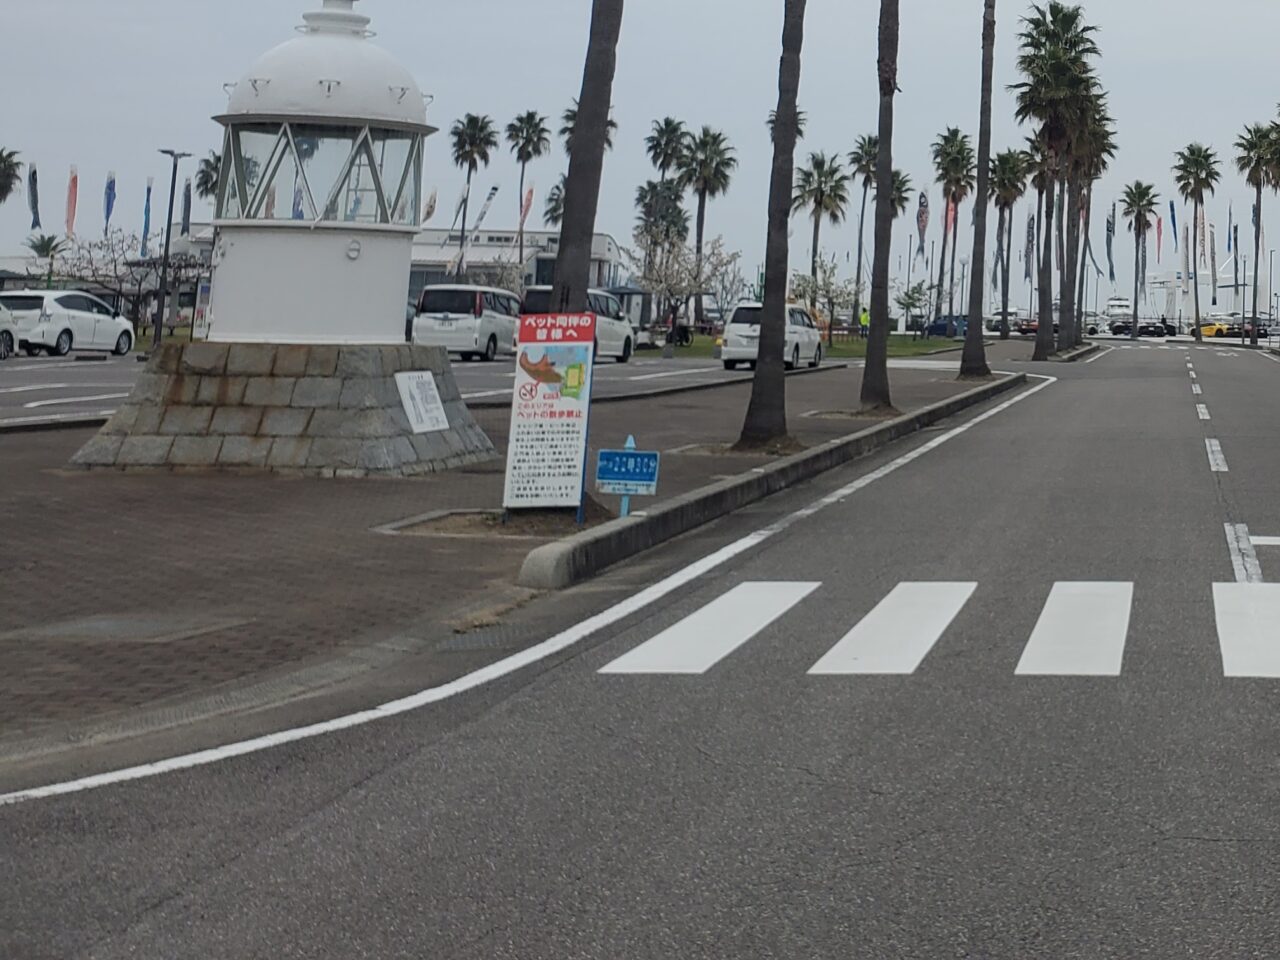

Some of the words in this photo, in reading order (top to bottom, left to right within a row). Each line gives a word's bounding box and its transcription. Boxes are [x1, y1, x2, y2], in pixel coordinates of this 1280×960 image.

[525, 315, 591, 327] ペット同伴の
